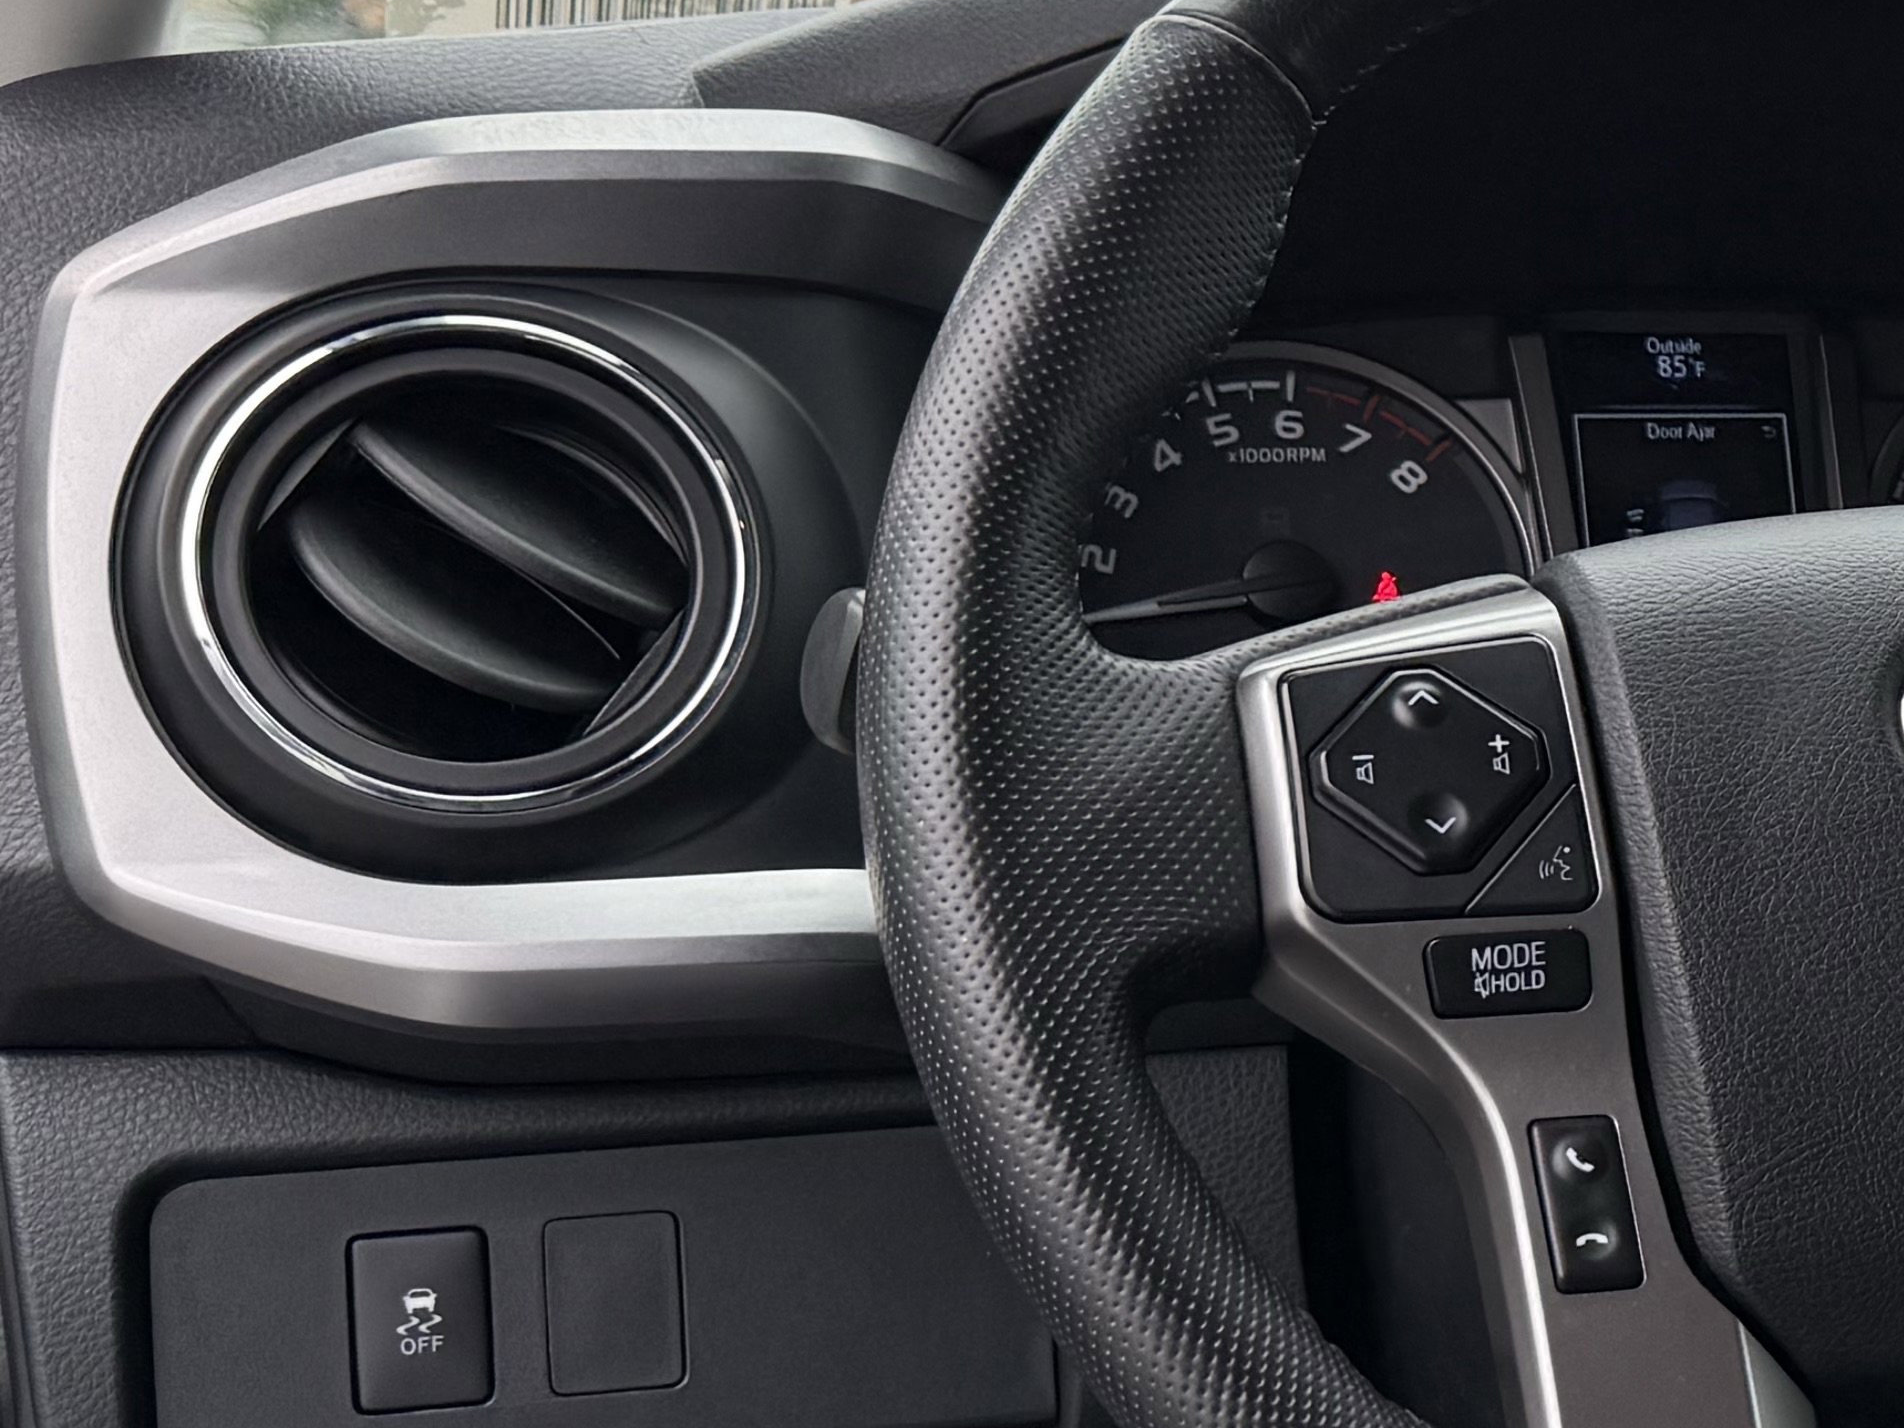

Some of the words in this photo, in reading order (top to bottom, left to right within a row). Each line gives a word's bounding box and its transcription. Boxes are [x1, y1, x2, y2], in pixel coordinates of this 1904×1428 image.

[1643, 335, 1703, 356] Outside
[1206, 412, 1241, 448] 5
[1273, 409, 1306, 441] 6
[1337, 422, 1373, 454] 7
[1646, 421, 1683, 440] Door
[1686, 421, 1717, 443] Ajar
[1153, 438, 1183, 473] 4
[1226, 446, 1328, 465] x1000RPM
[1389, 459, 1429, 495] 8
[1104, 482, 1140, 519] 3
[1081, 543, 1117, 577] 2
[1471, 940, 1547, 971] MODE
[1491, 969, 1546, 994] HOLD
[398, 1332, 445, 1358] OFF
